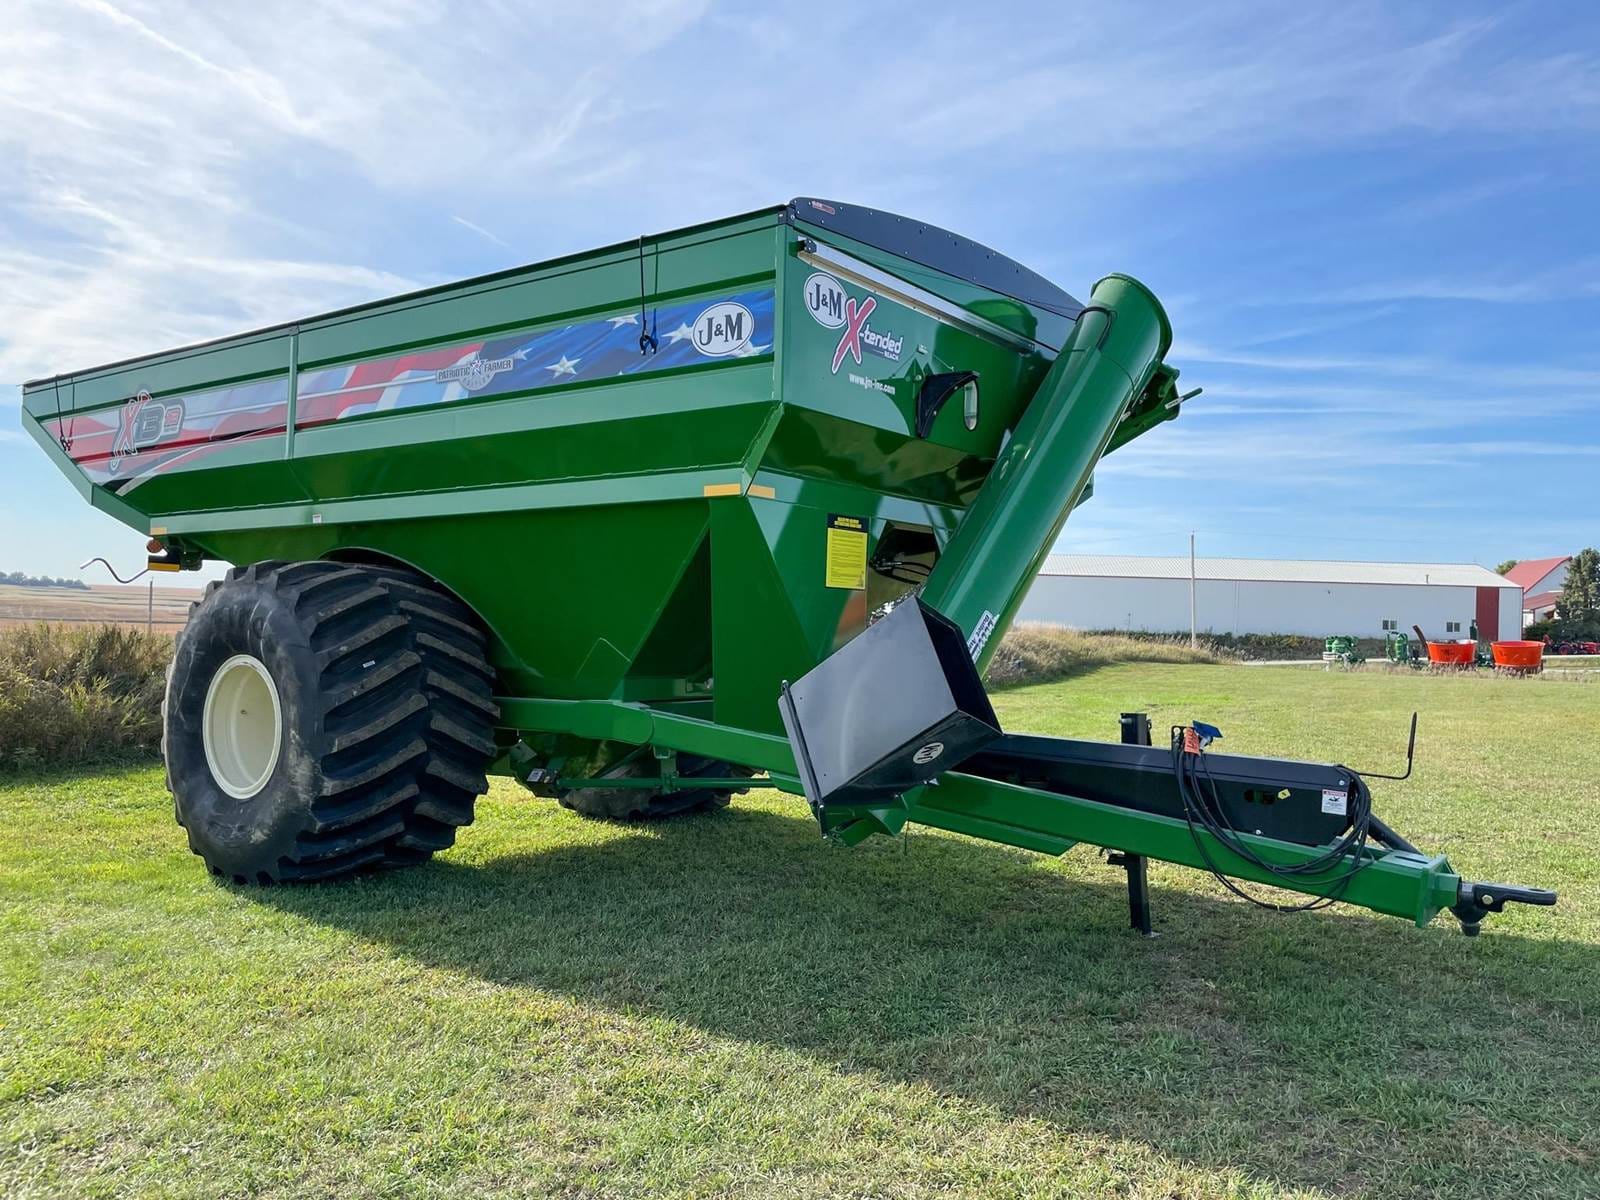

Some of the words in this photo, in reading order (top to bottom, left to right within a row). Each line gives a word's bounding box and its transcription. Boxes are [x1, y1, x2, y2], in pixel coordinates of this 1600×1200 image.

[809, 282, 843, 320] J&M
[698, 311, 744, 346] J&M
[438, 366, 471, 380] PATRIOTIC
[484, 359, 512, 373] FARMER
